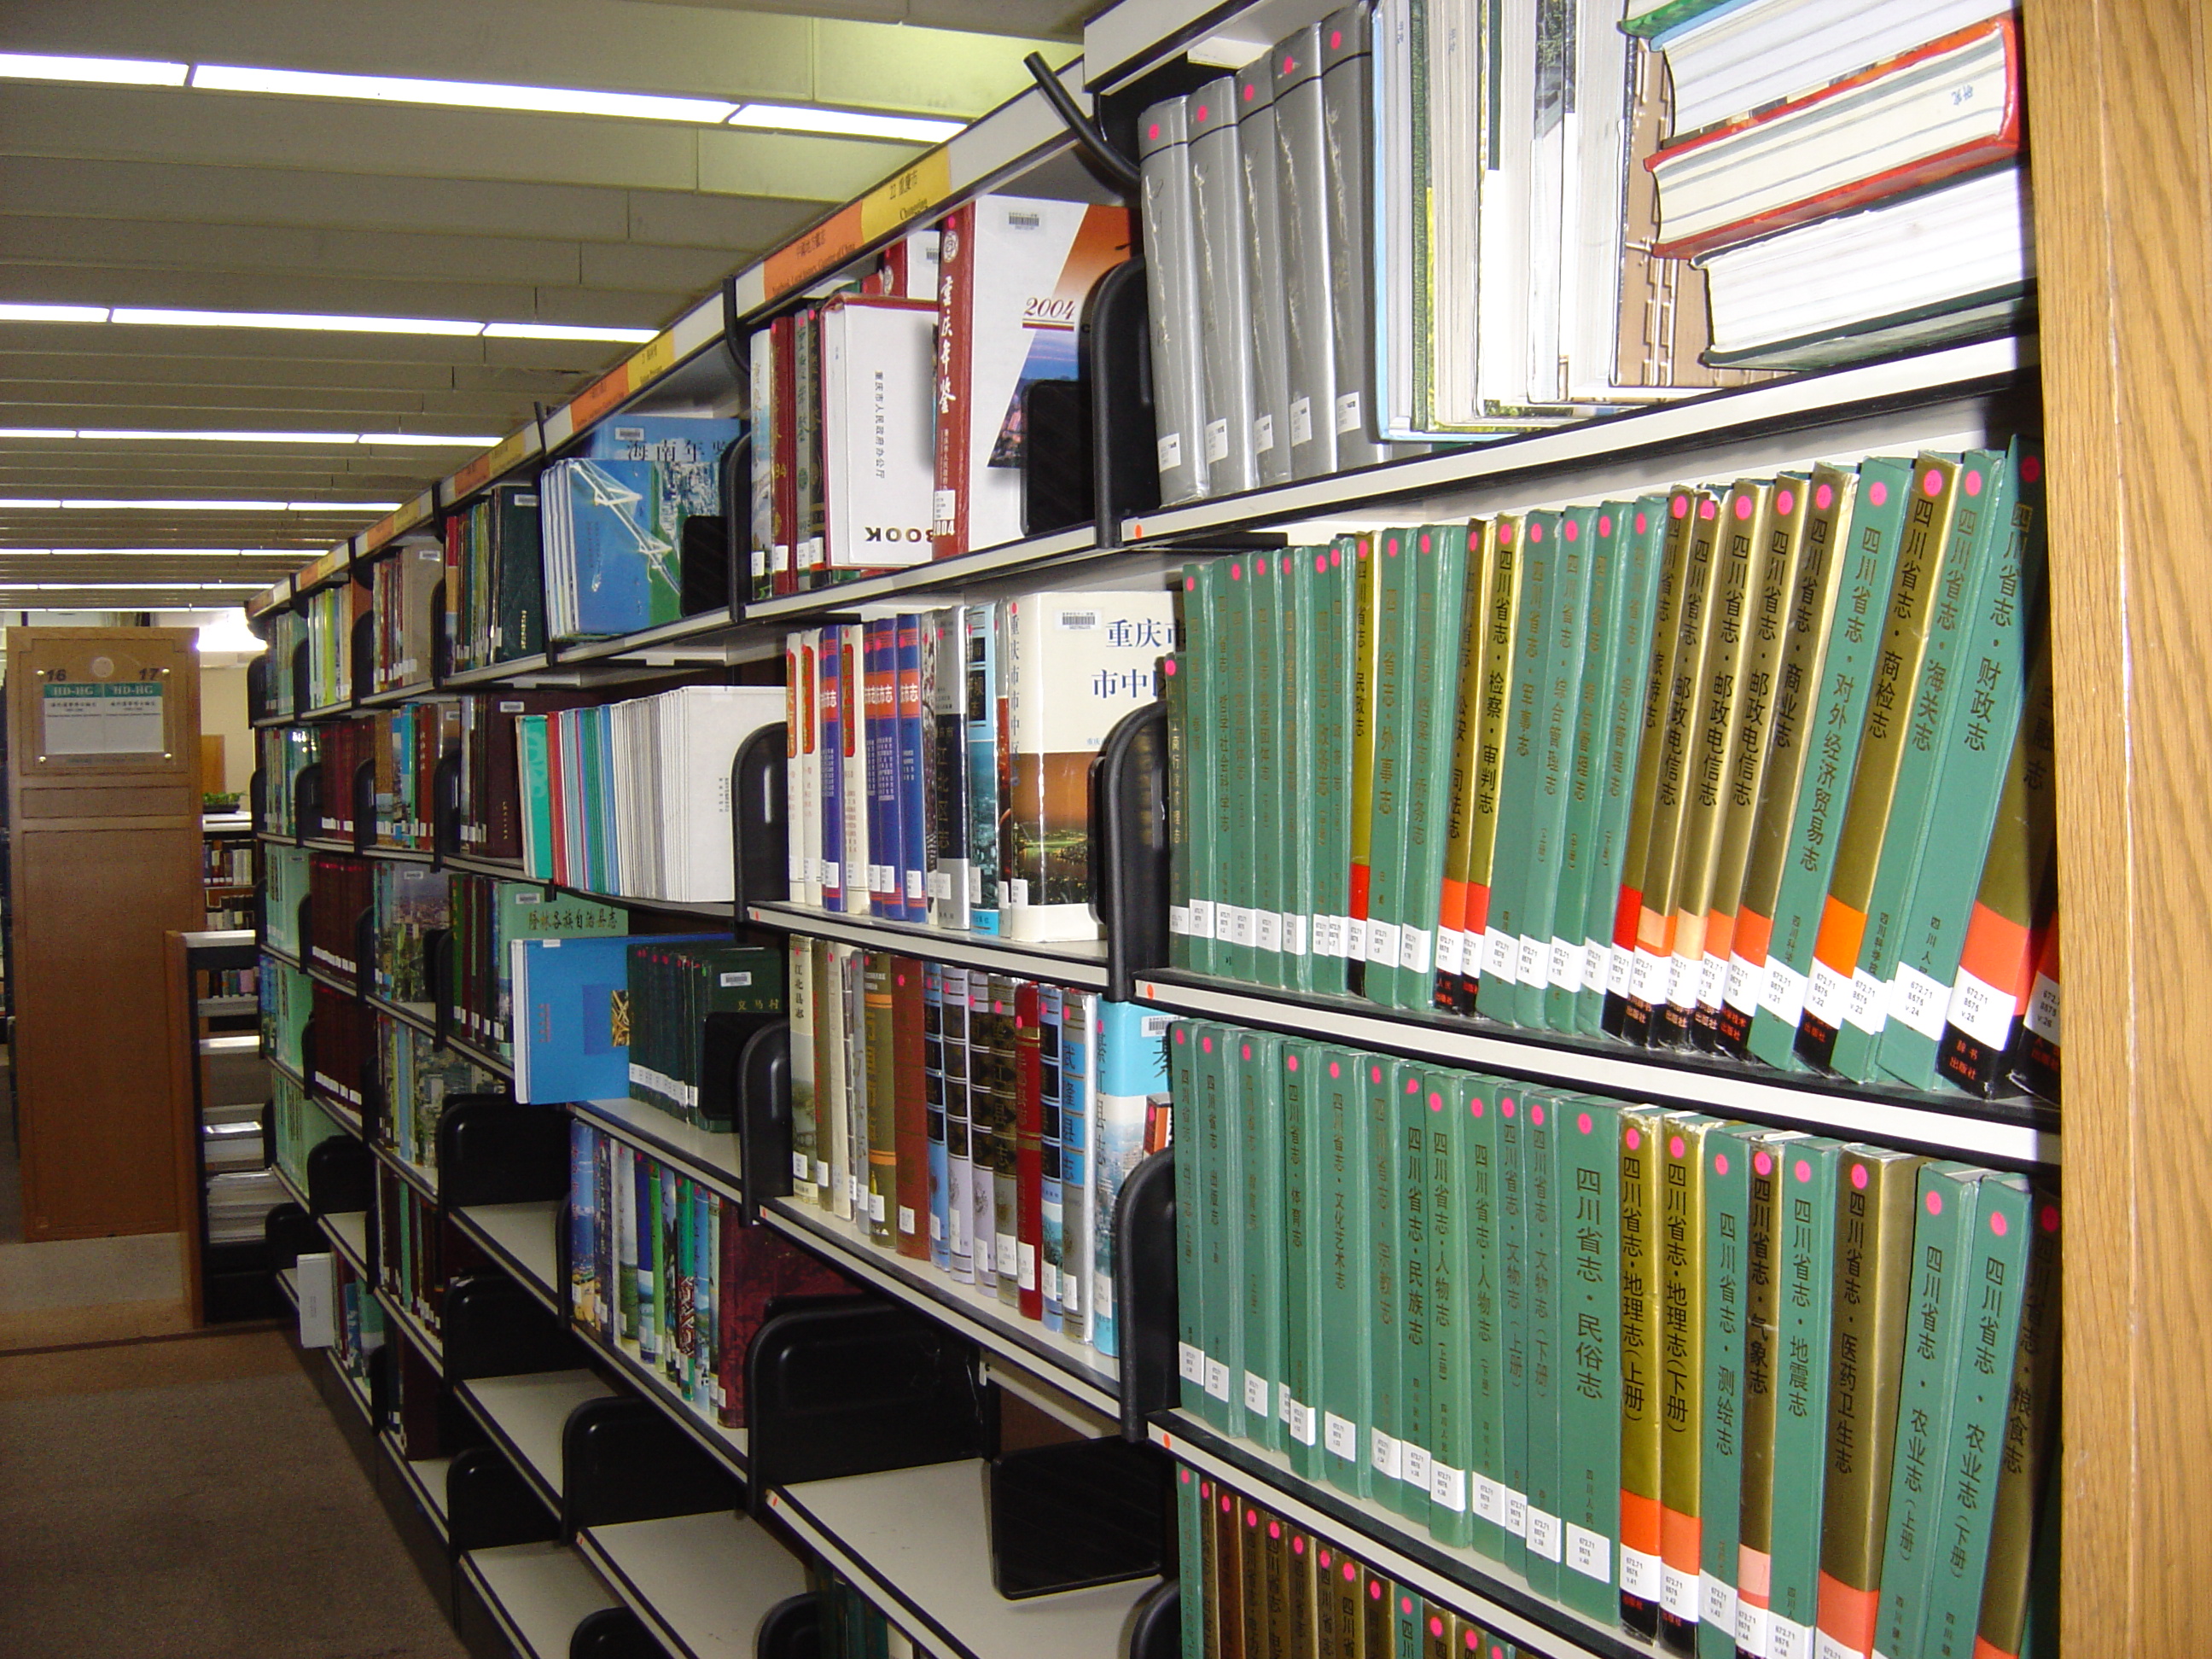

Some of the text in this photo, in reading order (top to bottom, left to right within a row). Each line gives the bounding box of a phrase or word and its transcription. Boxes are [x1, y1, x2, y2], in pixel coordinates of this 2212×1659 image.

[899, 197, 929, 221] Chongqing
[1023, 297, 1075, 321] 2004
[874, 370, 886, 479] 重庆市人民政府办公厅
[934, 519, 956, 537] 004
[46, 668, 67, 682] 16
[52, 685, 95, 696] HD-HG
[113, 684, 154, 696] HD-HG
[138, 667, 160, 681] 17
[1379, 589, 1397, 815] 四川省志·外事志
[1479, 550, 1513, 814] 四川省志·检察·审判志
[1660, 539, 1710, 806] 四川省志·邮政电信志
[1699, 535, 1750, 806] 四川省志·邮政电信志
[1733, 530, 1789, 806] 四川省志·邮政电信志
[1774, 518, 1828, 748] 四川省志·商业志
[1801, 526, 1882, 872] 四川省志·对外经济贸易志
[1869, 498, 1934, 739] 四川省志·商检志
[1912, 508, 1977, 752] 四川省志·海关志
[1964, 501, 2034, 752] 四川省志·财政志
[1855, 980, 1876, 997] 672.71
[1905, 1004, 1919, 1017] v.24
[1911, 981, 1933, 998] 672.71
[1948, 1056, 1976, 1081] 出版社
[1961, 1010, 1975, 1023] v.25
[1966, 987, 1988, 1004] 672.71
[1407, 1126, 1424, 1346] 四川省志·民族志
[1433, 1132, 1450, 1327] 四川省志·人物志
[1474, 1144, 1491, 1342] 四川省志·人物志
[1575, 1167, 1604, 1400] 四川省志·民俗志
[1622, 1156, 1645, 1422] 四川省志·地理志（上册）
[1665, 1163, 1689, 1434] 四川省志·地理志（下册）
[1715, 1212, 1737, 1458] 四川省志·测绘志
[1748, 1177, 1772, 1395] 四川省志·气象志
[1788, 1198, 1812, 1417] 四川省志·地震志
[1835, 1190, 1866, 1475] 四川省志·医药卫生志
[1899, 1245, 1943, 1561] 四川省志·农业志（上册）
[1949, 1256, 2005, 1579] 四川省志·农业志（下册）
